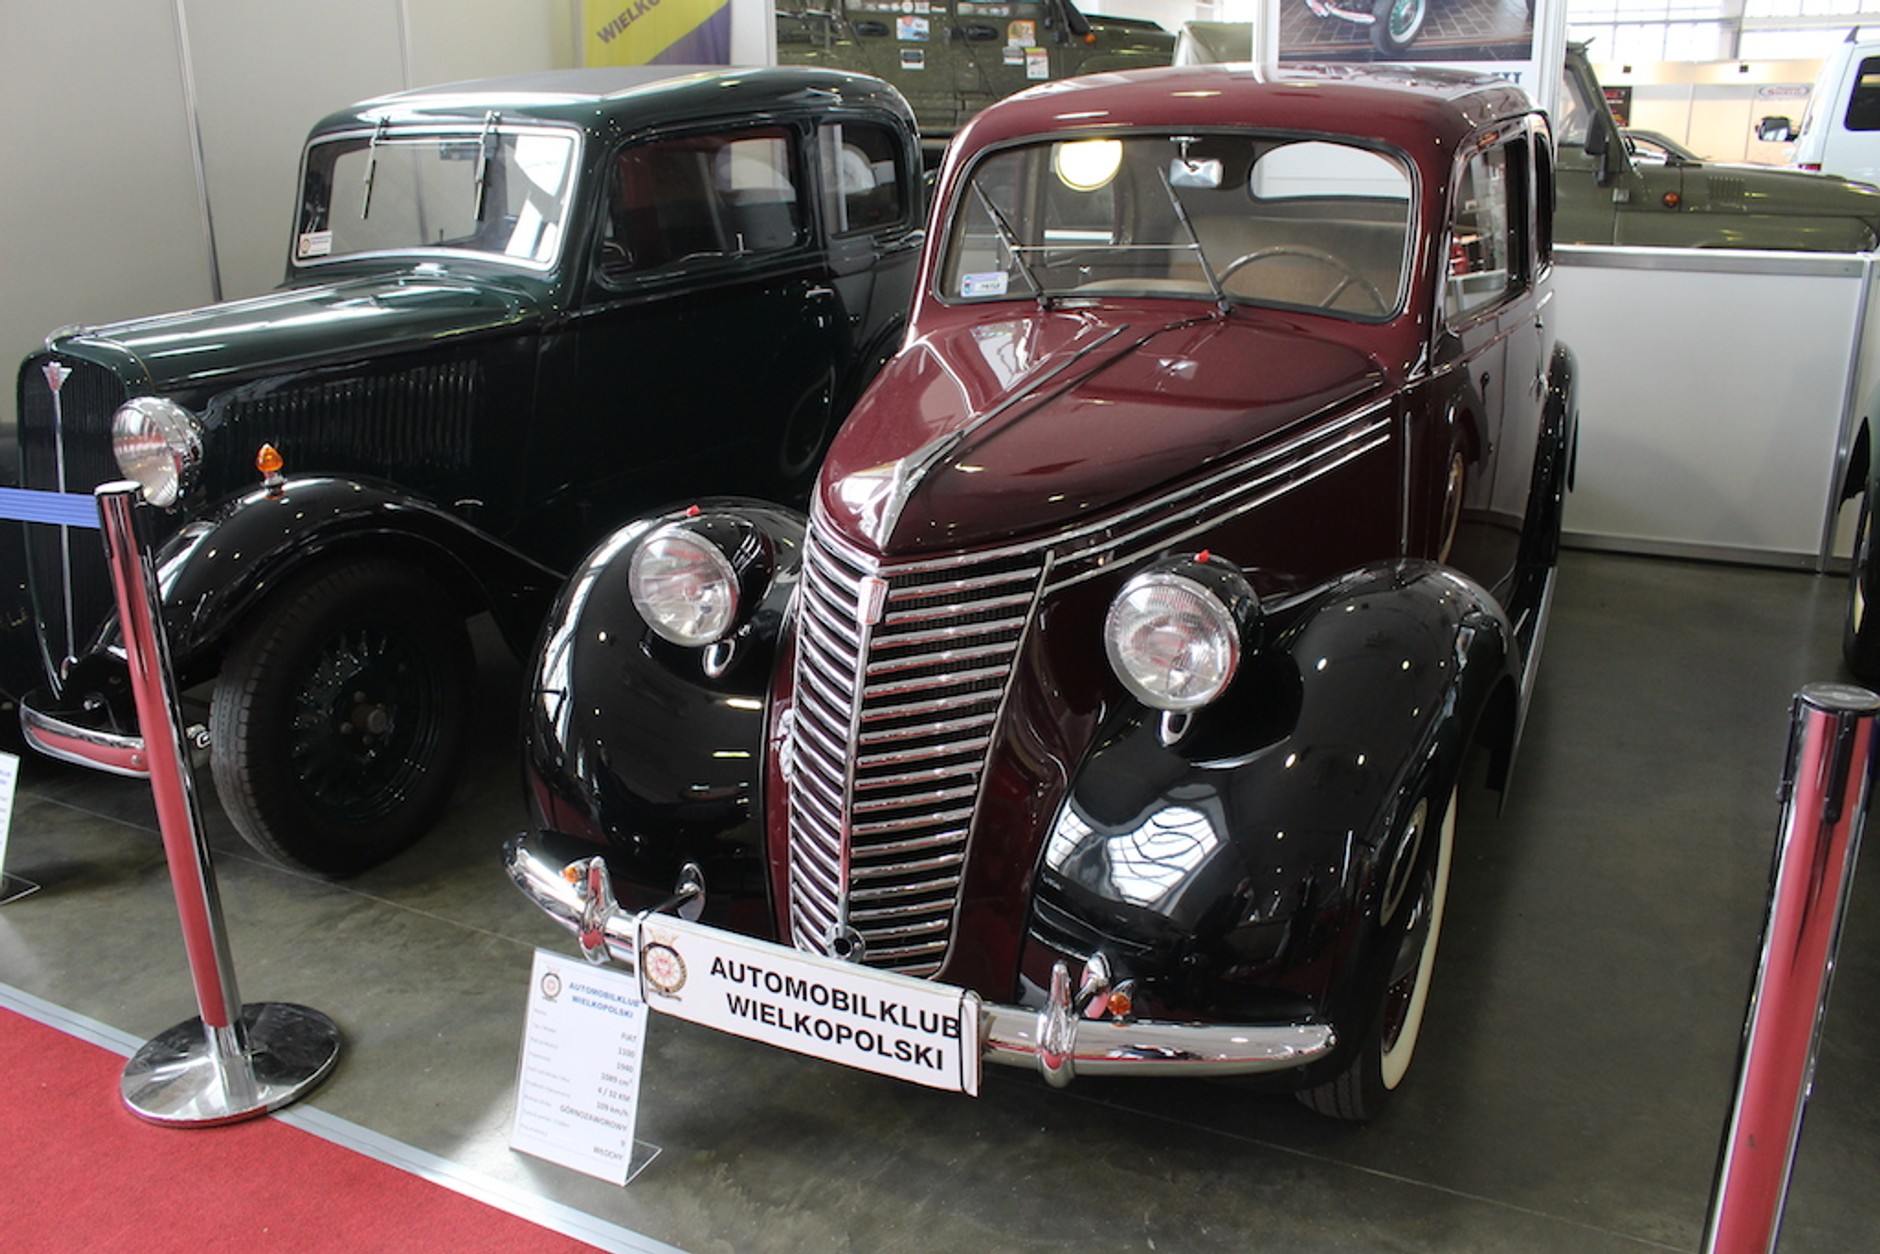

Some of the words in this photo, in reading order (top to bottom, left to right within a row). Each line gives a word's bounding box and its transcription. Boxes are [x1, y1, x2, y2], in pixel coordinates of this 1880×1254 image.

[569, 982, 641, 1007] AUTOMOBILKLUB
[710, 956, 960, 1039] AUTOMOBILKLUB
[572, 995, 634, 1019] WIELKOPOLSKI
[621, 1032, 637, 1042] FIAT
[726, 993, 944, 1071] WIELKOPOLSKI
[616, 1062, 634, 1073] 1940
